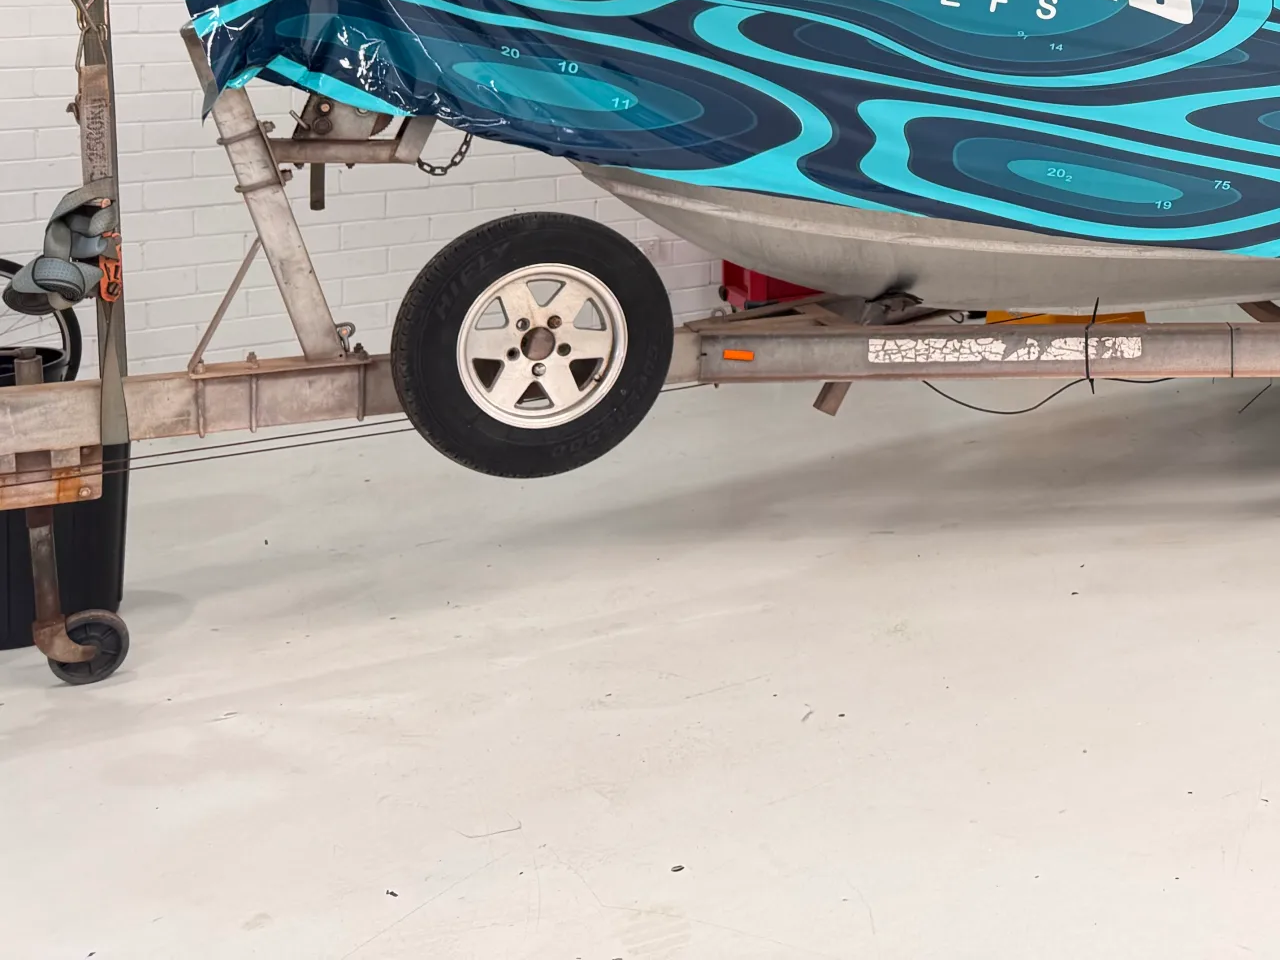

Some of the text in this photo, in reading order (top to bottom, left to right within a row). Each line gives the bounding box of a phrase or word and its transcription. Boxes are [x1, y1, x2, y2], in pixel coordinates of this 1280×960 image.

[500, 45, 520, 59] 20
[1049, 42, 1063, 52] 14
[557, 60, 579, 74] 10
[611, 97, 630, 110] 11
[1213, 179, 1231, 191] 75
[1154, 200, 1172, 210] 19
